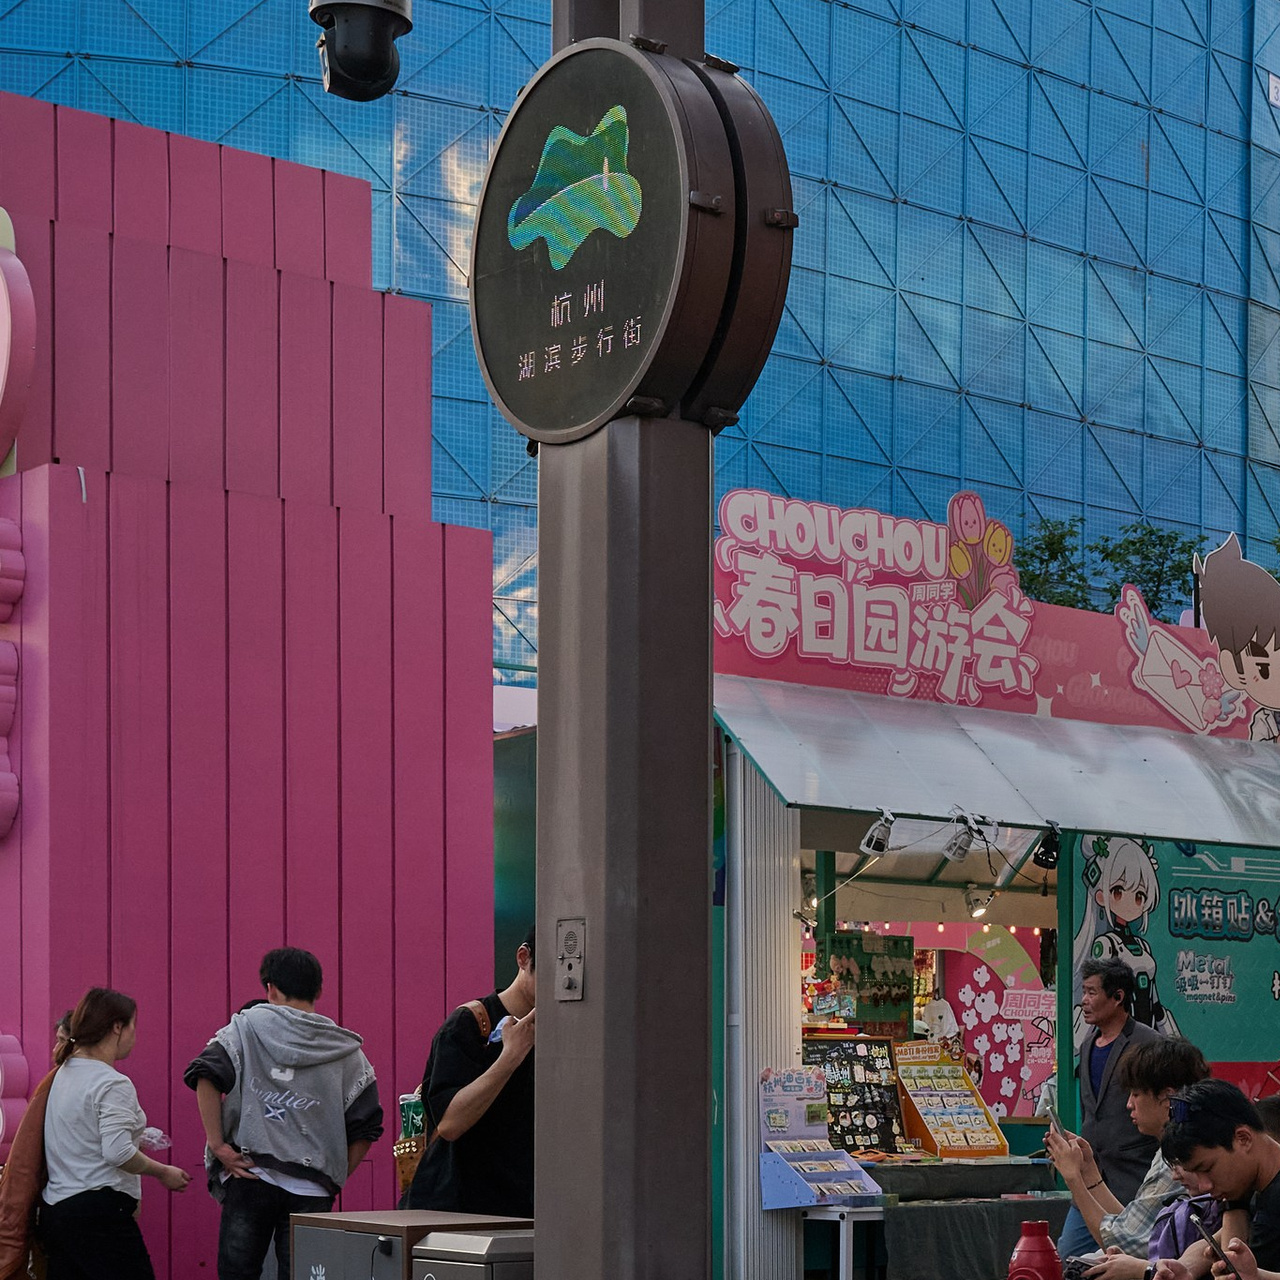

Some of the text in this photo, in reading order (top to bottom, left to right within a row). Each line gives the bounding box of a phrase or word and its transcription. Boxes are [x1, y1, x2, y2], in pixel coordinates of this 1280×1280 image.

[552, 279, 605, 328] 杭州
[518, 316, 642, 382] 湖滨步行街
[727, 492, 948, 579] CHOUCHOU
[911, 582, 956, 602] 周同学
[729, 551, 1031, 701] 春日园游会
[1177, 950, 1231, 976] Metal
